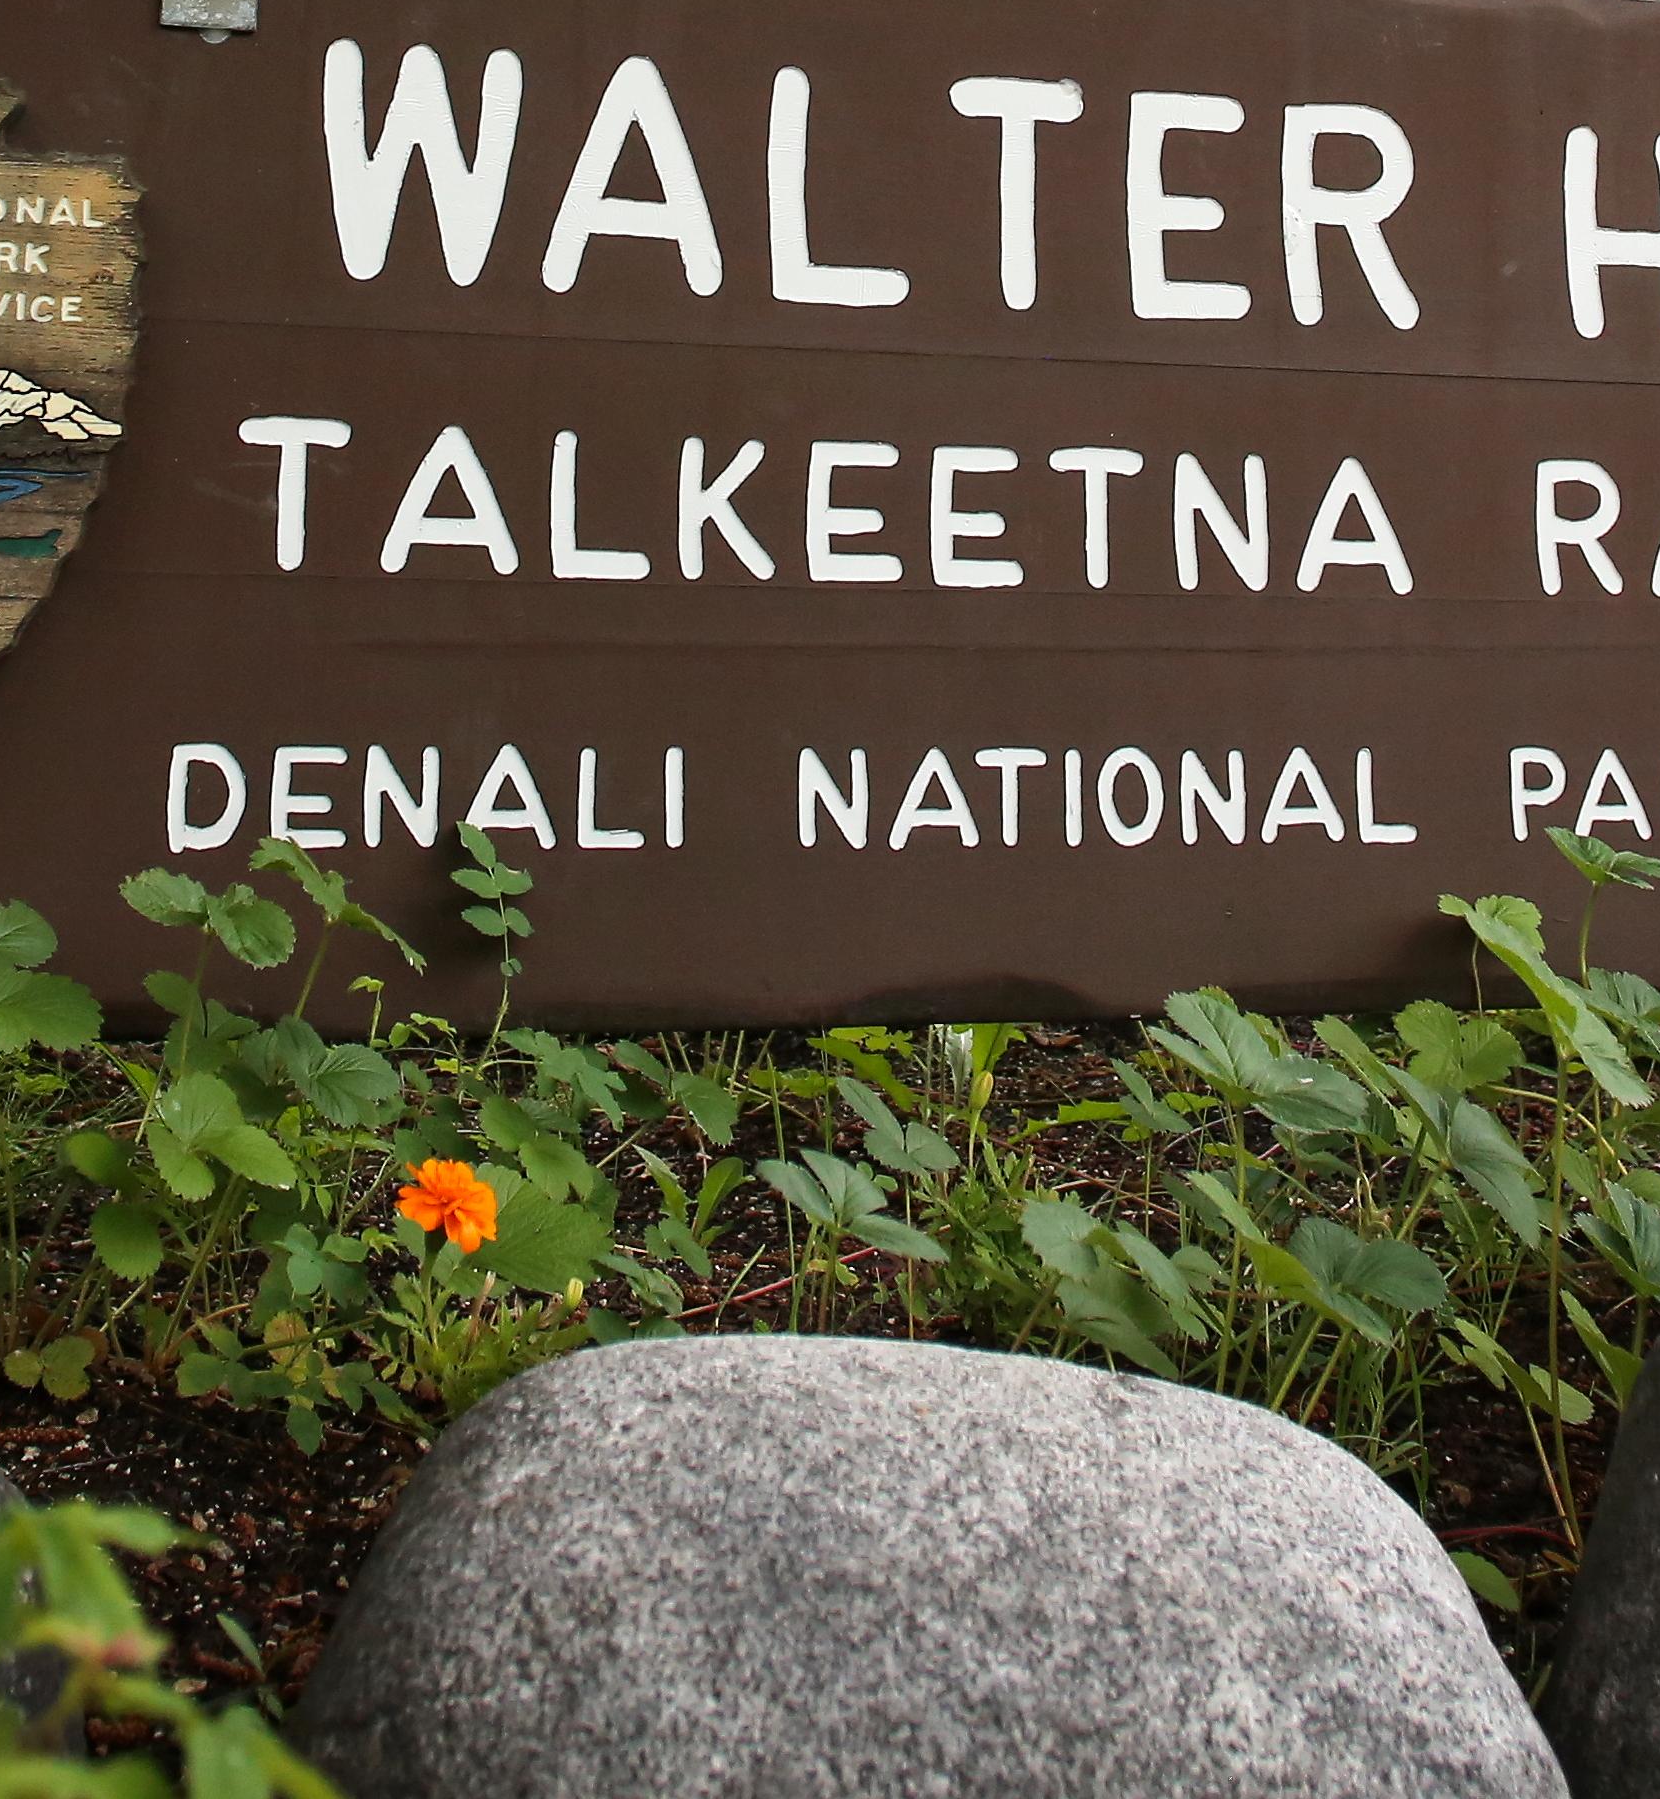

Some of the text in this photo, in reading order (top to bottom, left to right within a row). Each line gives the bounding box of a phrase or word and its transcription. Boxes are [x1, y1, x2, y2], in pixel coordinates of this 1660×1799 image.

[322, 38, 1421, 331] WALTER
[237, 415, 1415, 597] TALKEETNA
[165, 742, 685, 854] DENALI
[797, 746, 1419, 852] NATIONAL
